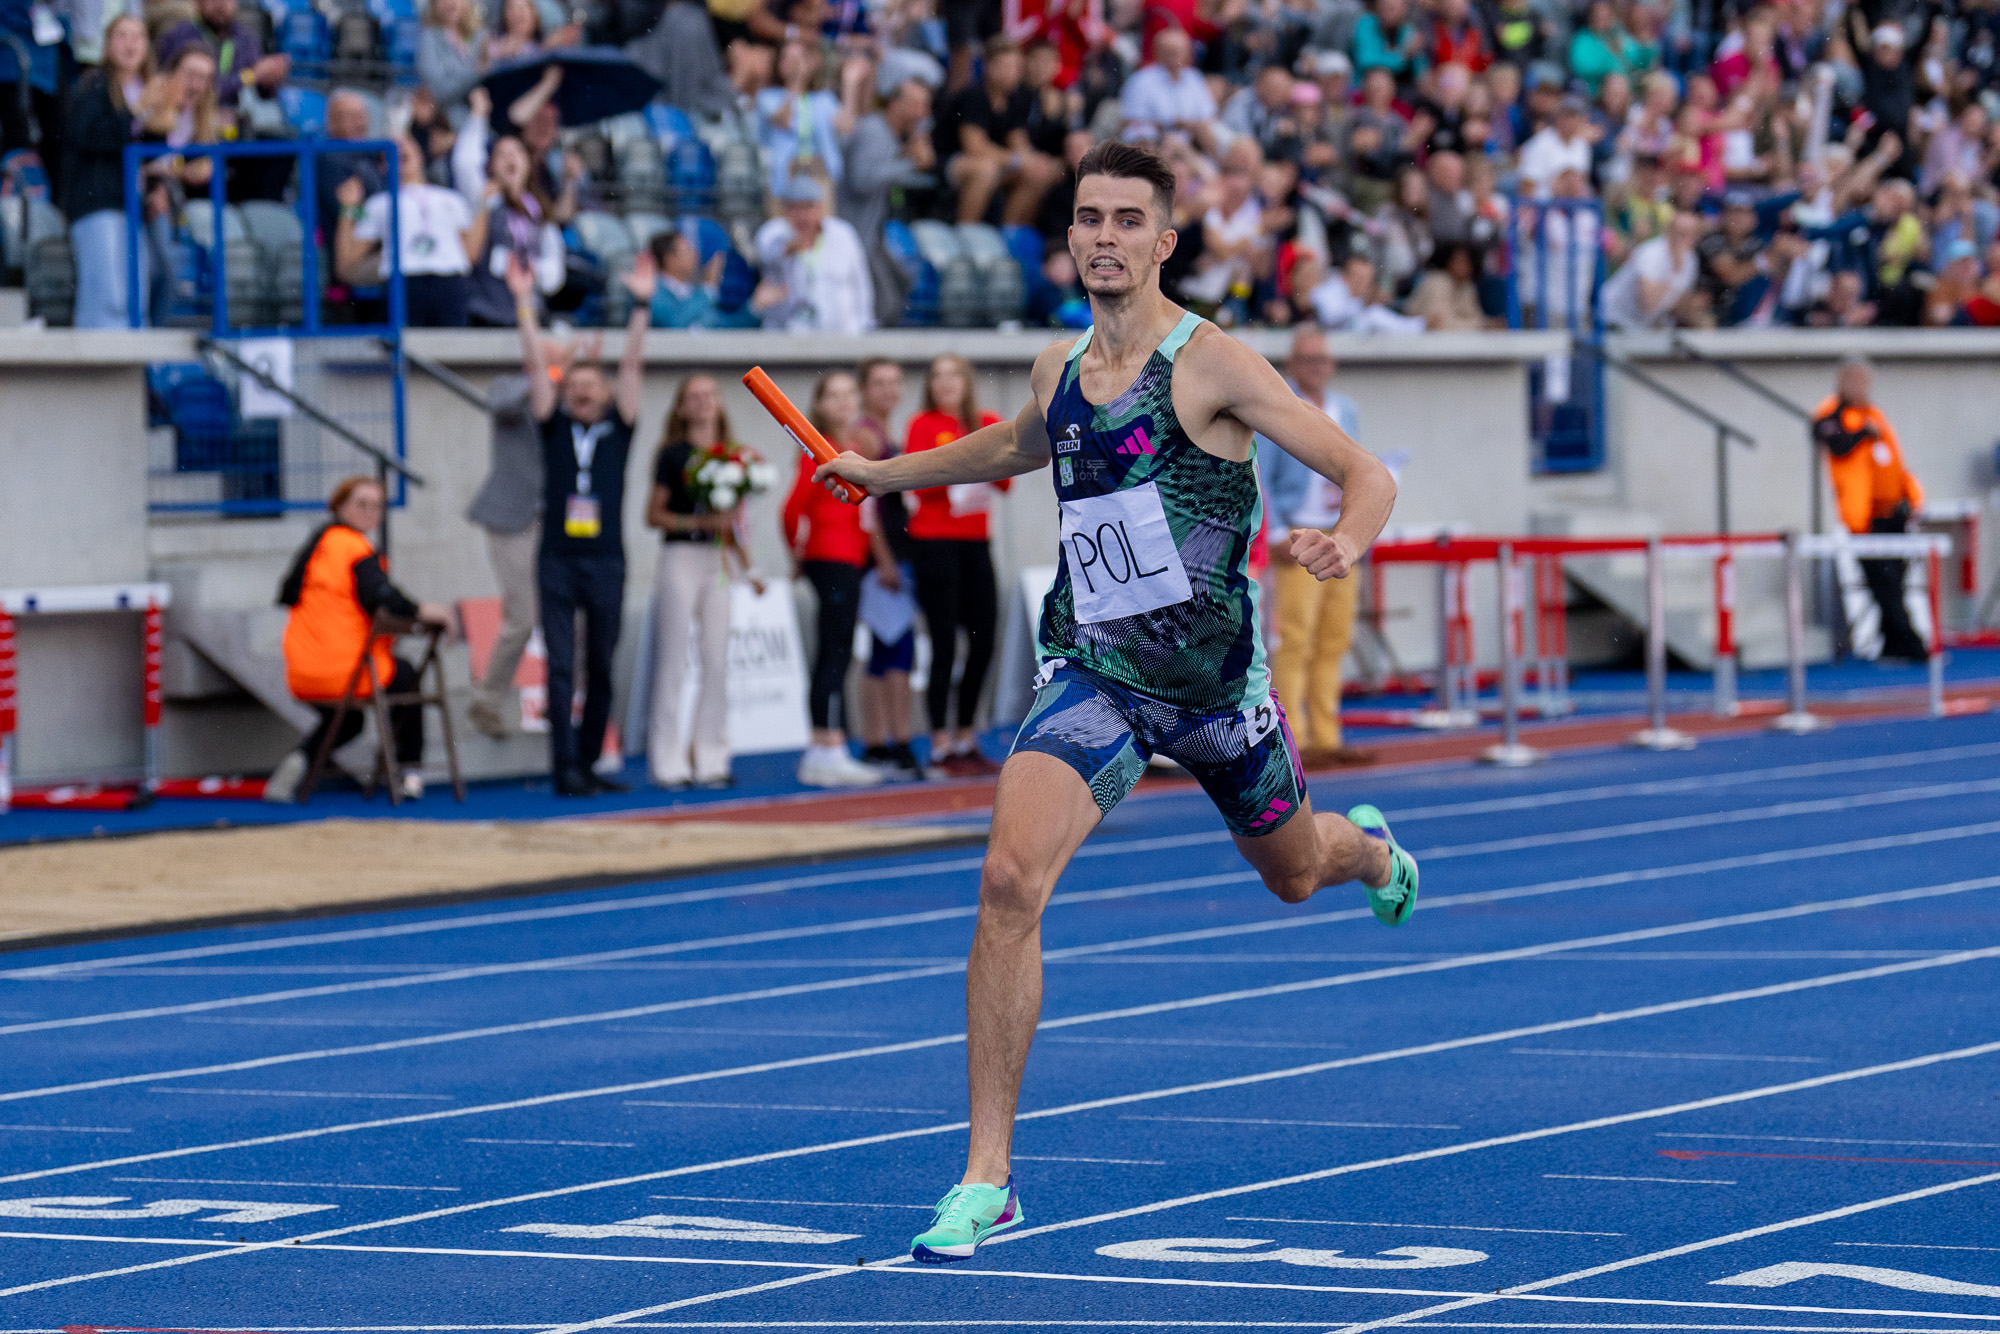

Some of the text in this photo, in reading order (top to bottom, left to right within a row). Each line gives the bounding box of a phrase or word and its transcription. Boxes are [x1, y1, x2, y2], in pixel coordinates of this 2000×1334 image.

[1058, 440, 1079, 452] ORLEN
[1071, 520, 1169, 593] POL
[1254, 705, 1272, 735] 5
[0, 1196, 340, 1223] 5
[500, 1214, 864, 1244] 4
[1095, 1237, 1489, 1270] 3
